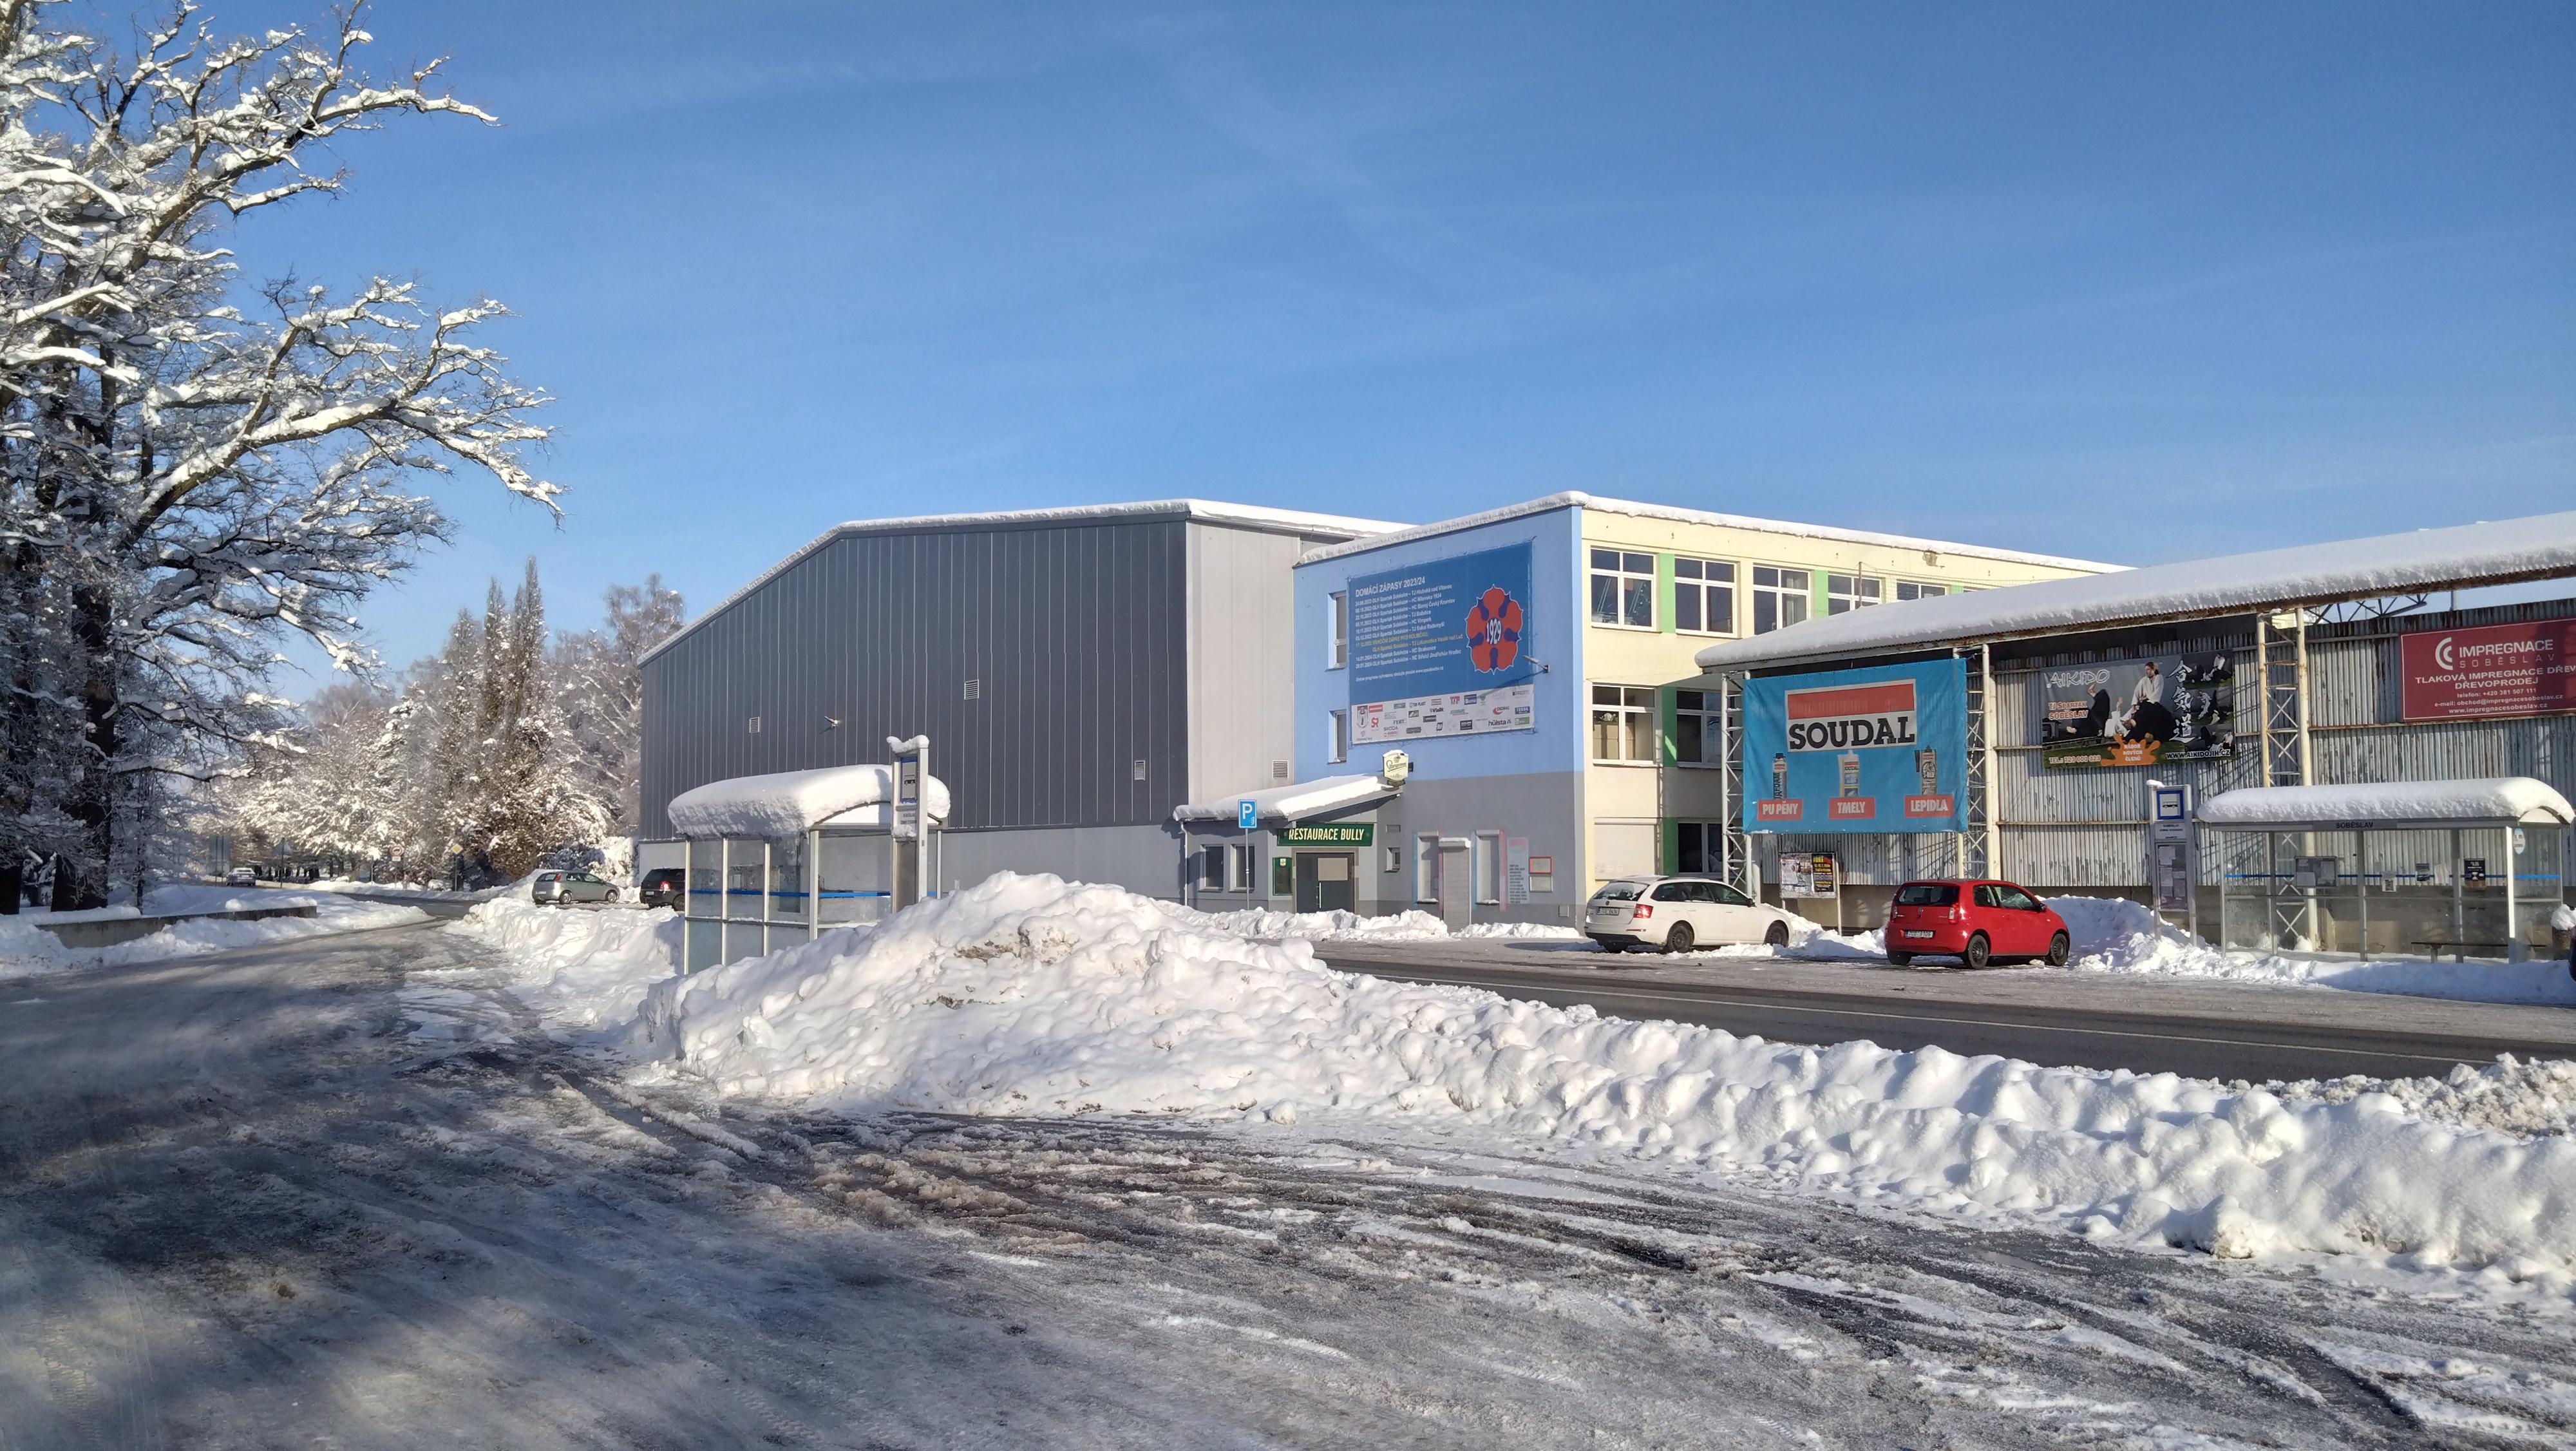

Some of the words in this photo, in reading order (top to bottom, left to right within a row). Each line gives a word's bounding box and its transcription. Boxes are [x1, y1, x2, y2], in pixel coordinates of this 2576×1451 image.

[1355, 583, 1378, 598] DOMÁCÍ
[1379, 581, 1403, 593] ZÁPASY
[1403, 576, 1425, 587] 2023/24
[1486, 618, 1501, 644] 1929
[2459, 639, 2553, 658] IMPREGNACE
[2459, 654, 2555, 668] SOBĚSLAV
[2046, 669, 2110, 688] AIKIDO
[2415, 672, 2466, 685] TLAKOVÁ
[2469, 667, 2544, 679] IMPREGNACE
[2547, 665, 2576, 674] DŘEV
[2455, 676, 2539, 690] DŘEVOPRODEJ
[2057, 701, 2088, 710] SPARTAK
[2457, 694, 2564, 706] obchod@impregnacesobeslav.cz
[2049, 710, 2088, 720] SOBĚSLAV
[2448, 703, 2548, 714] www.impregnacesobeslav.cz
[1789, 716, 1915, 750] SOUDAL
[2166, 749, 2231, 759] WWW.AIKIDOJIH.CZ
[1242, 804, 1253, 819] P
[1762, 804, 1775, 815] PU
[1776, 801, 1798, 815] PĚNY
[1837, 802, 1866, 813] TMELY
[1911, 799, 1949, 812] LEPIDLA
[1289, 828, 1338, 840] RESTAURACE
[1341, 828, 1364, 840] BULLY
